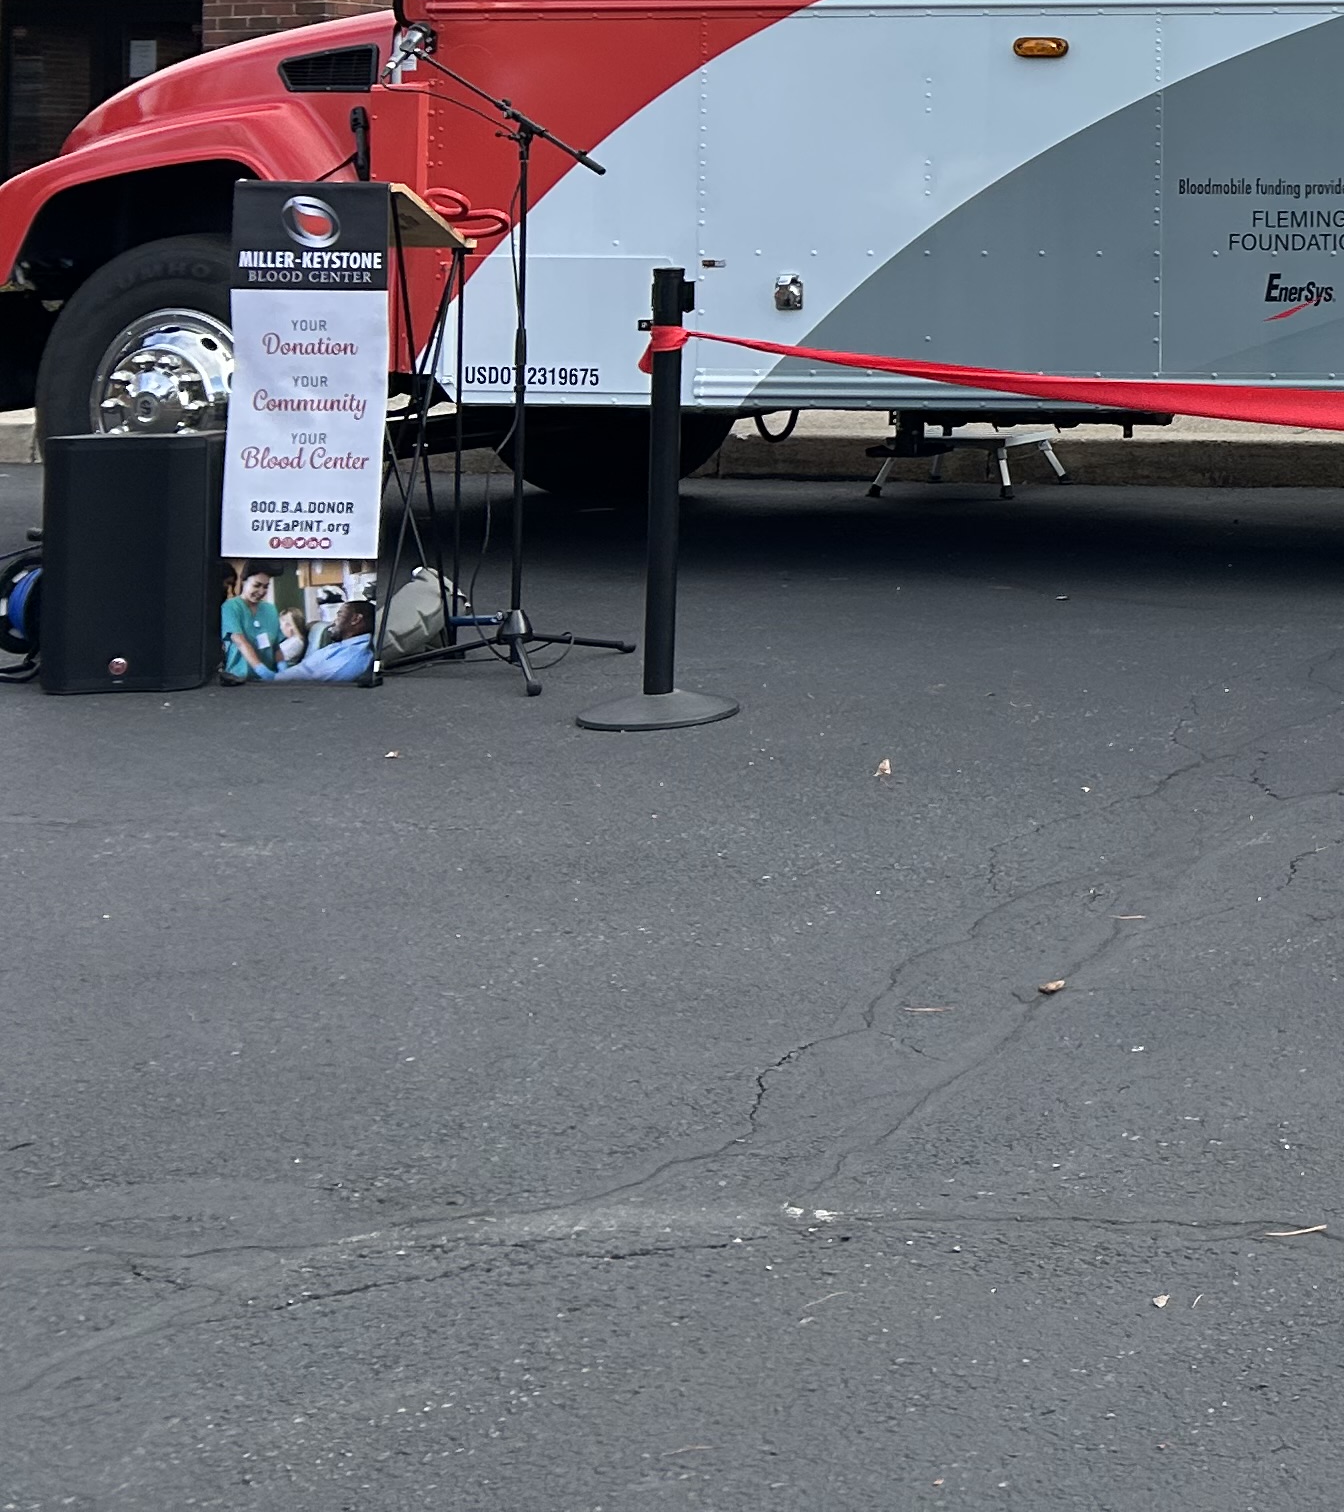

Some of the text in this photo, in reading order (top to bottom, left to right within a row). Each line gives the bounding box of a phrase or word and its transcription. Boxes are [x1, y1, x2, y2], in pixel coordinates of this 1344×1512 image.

[1178, 178, 1252, 195] Bloodmobile
[1256, 178, 1301, 199] funding
[238, 250, 383, 270] MILLER-KEYSTONE
[248, 270, 373, 284] BLOOD CENTER
[1264, 273, 1334, 307] EnerSys
[291, 319, 328, 332] YOUR
[262, 332, 359, 356] Donation
[292, 375, 328, 388] YOUR
[527, 367, 600, 386] 2319675
[252, 388, 367, 420] Community
[291, 432, 328, 445] YOUR
[240, 445, 370, 470] Blood Center
[250, 500, 355, 514] 800.B.A.DONOR
[251, 519, 350, 536] GIVEaPINT.org
